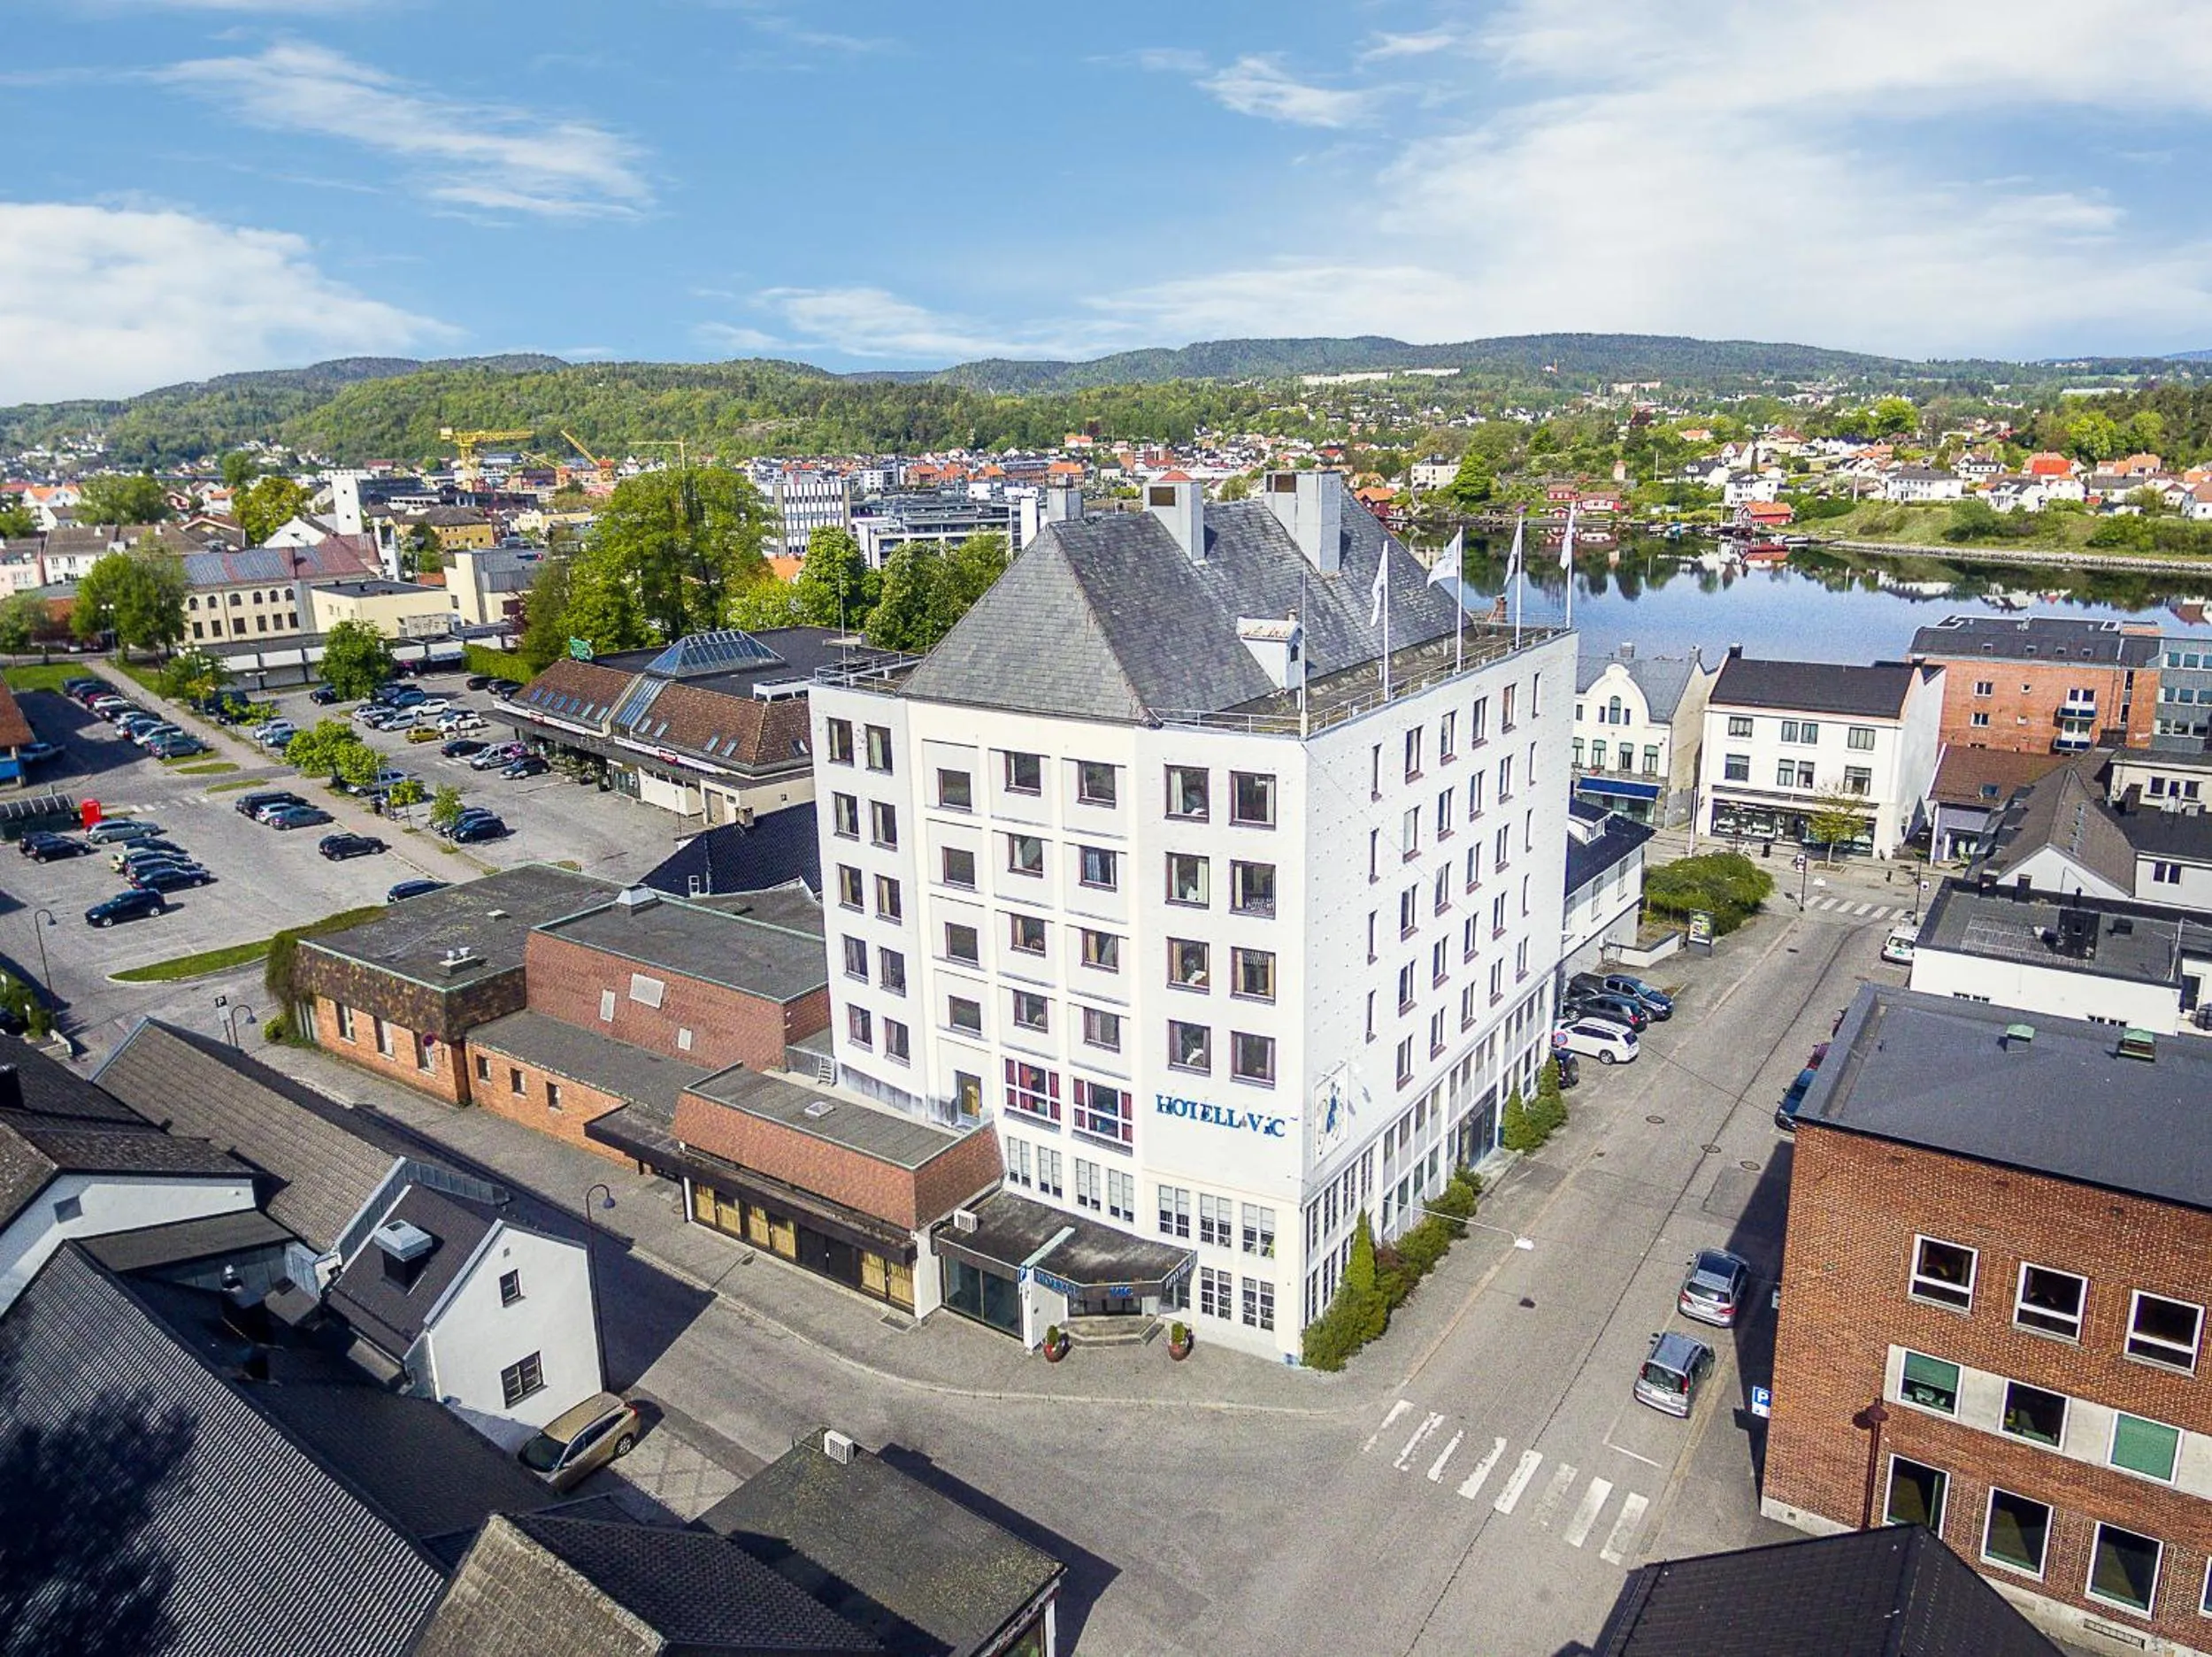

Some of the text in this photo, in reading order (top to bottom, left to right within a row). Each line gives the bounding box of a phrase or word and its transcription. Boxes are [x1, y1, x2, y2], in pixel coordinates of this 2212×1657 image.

[218, 997, 224, 1006] P
[1156, 1094, 1240, 1129] HOTELL
[1757, 1390, 1769, 1403] P
